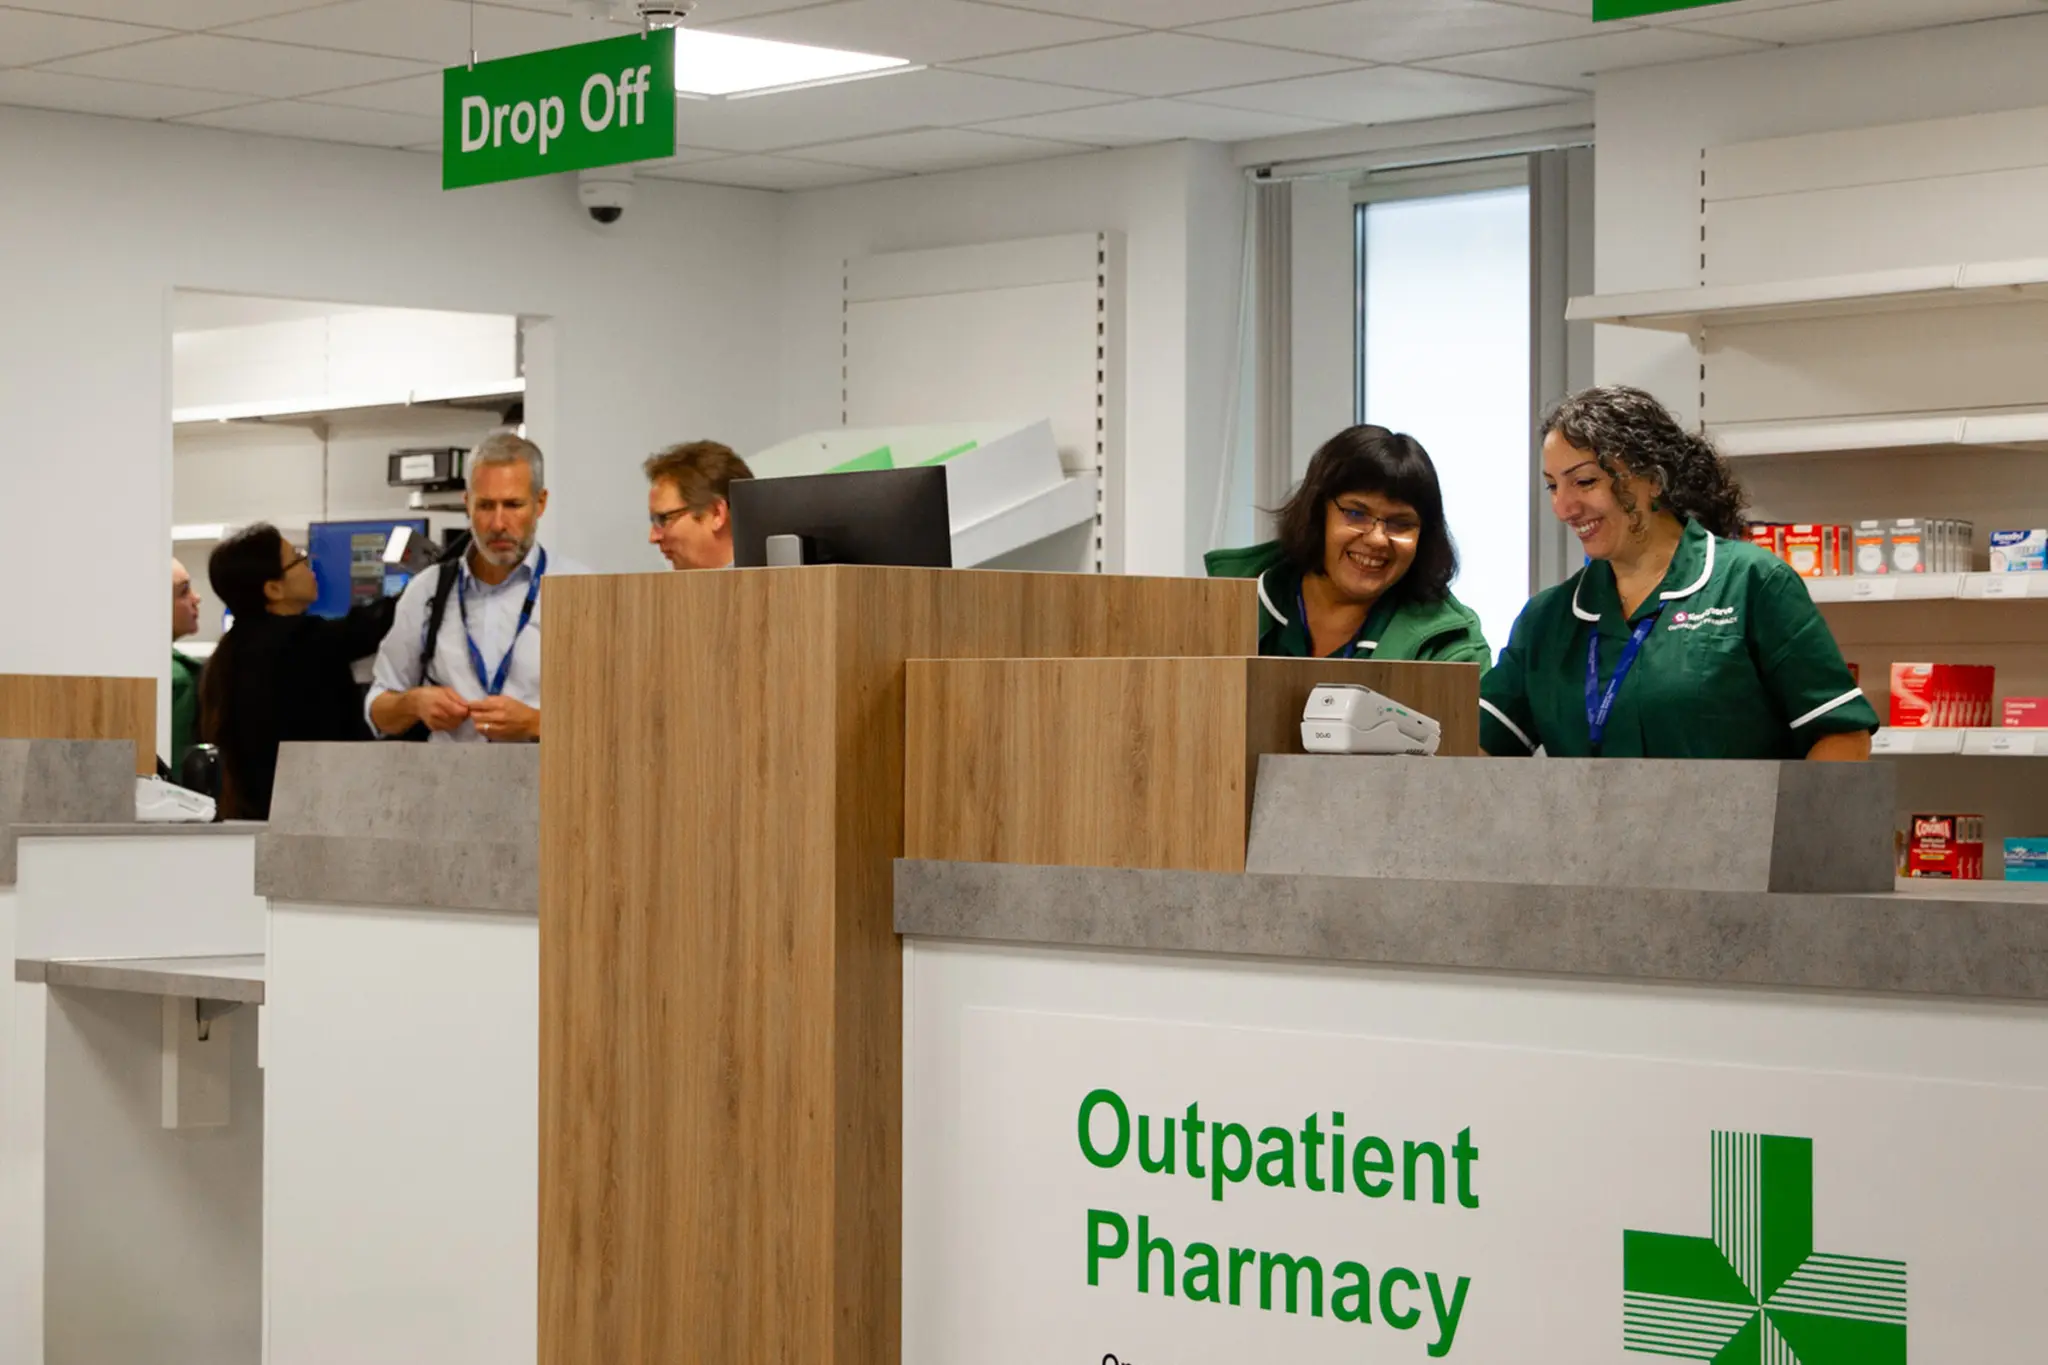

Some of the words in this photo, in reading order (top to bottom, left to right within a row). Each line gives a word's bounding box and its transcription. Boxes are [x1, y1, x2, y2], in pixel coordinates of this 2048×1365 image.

[461, 95, 565, 156] Drop
[580, 65, 652, 133] Off
[1077, 1088, 1480, 1210] Outpatient
[1087, 1208, 1472, 1359] Pharmacy
